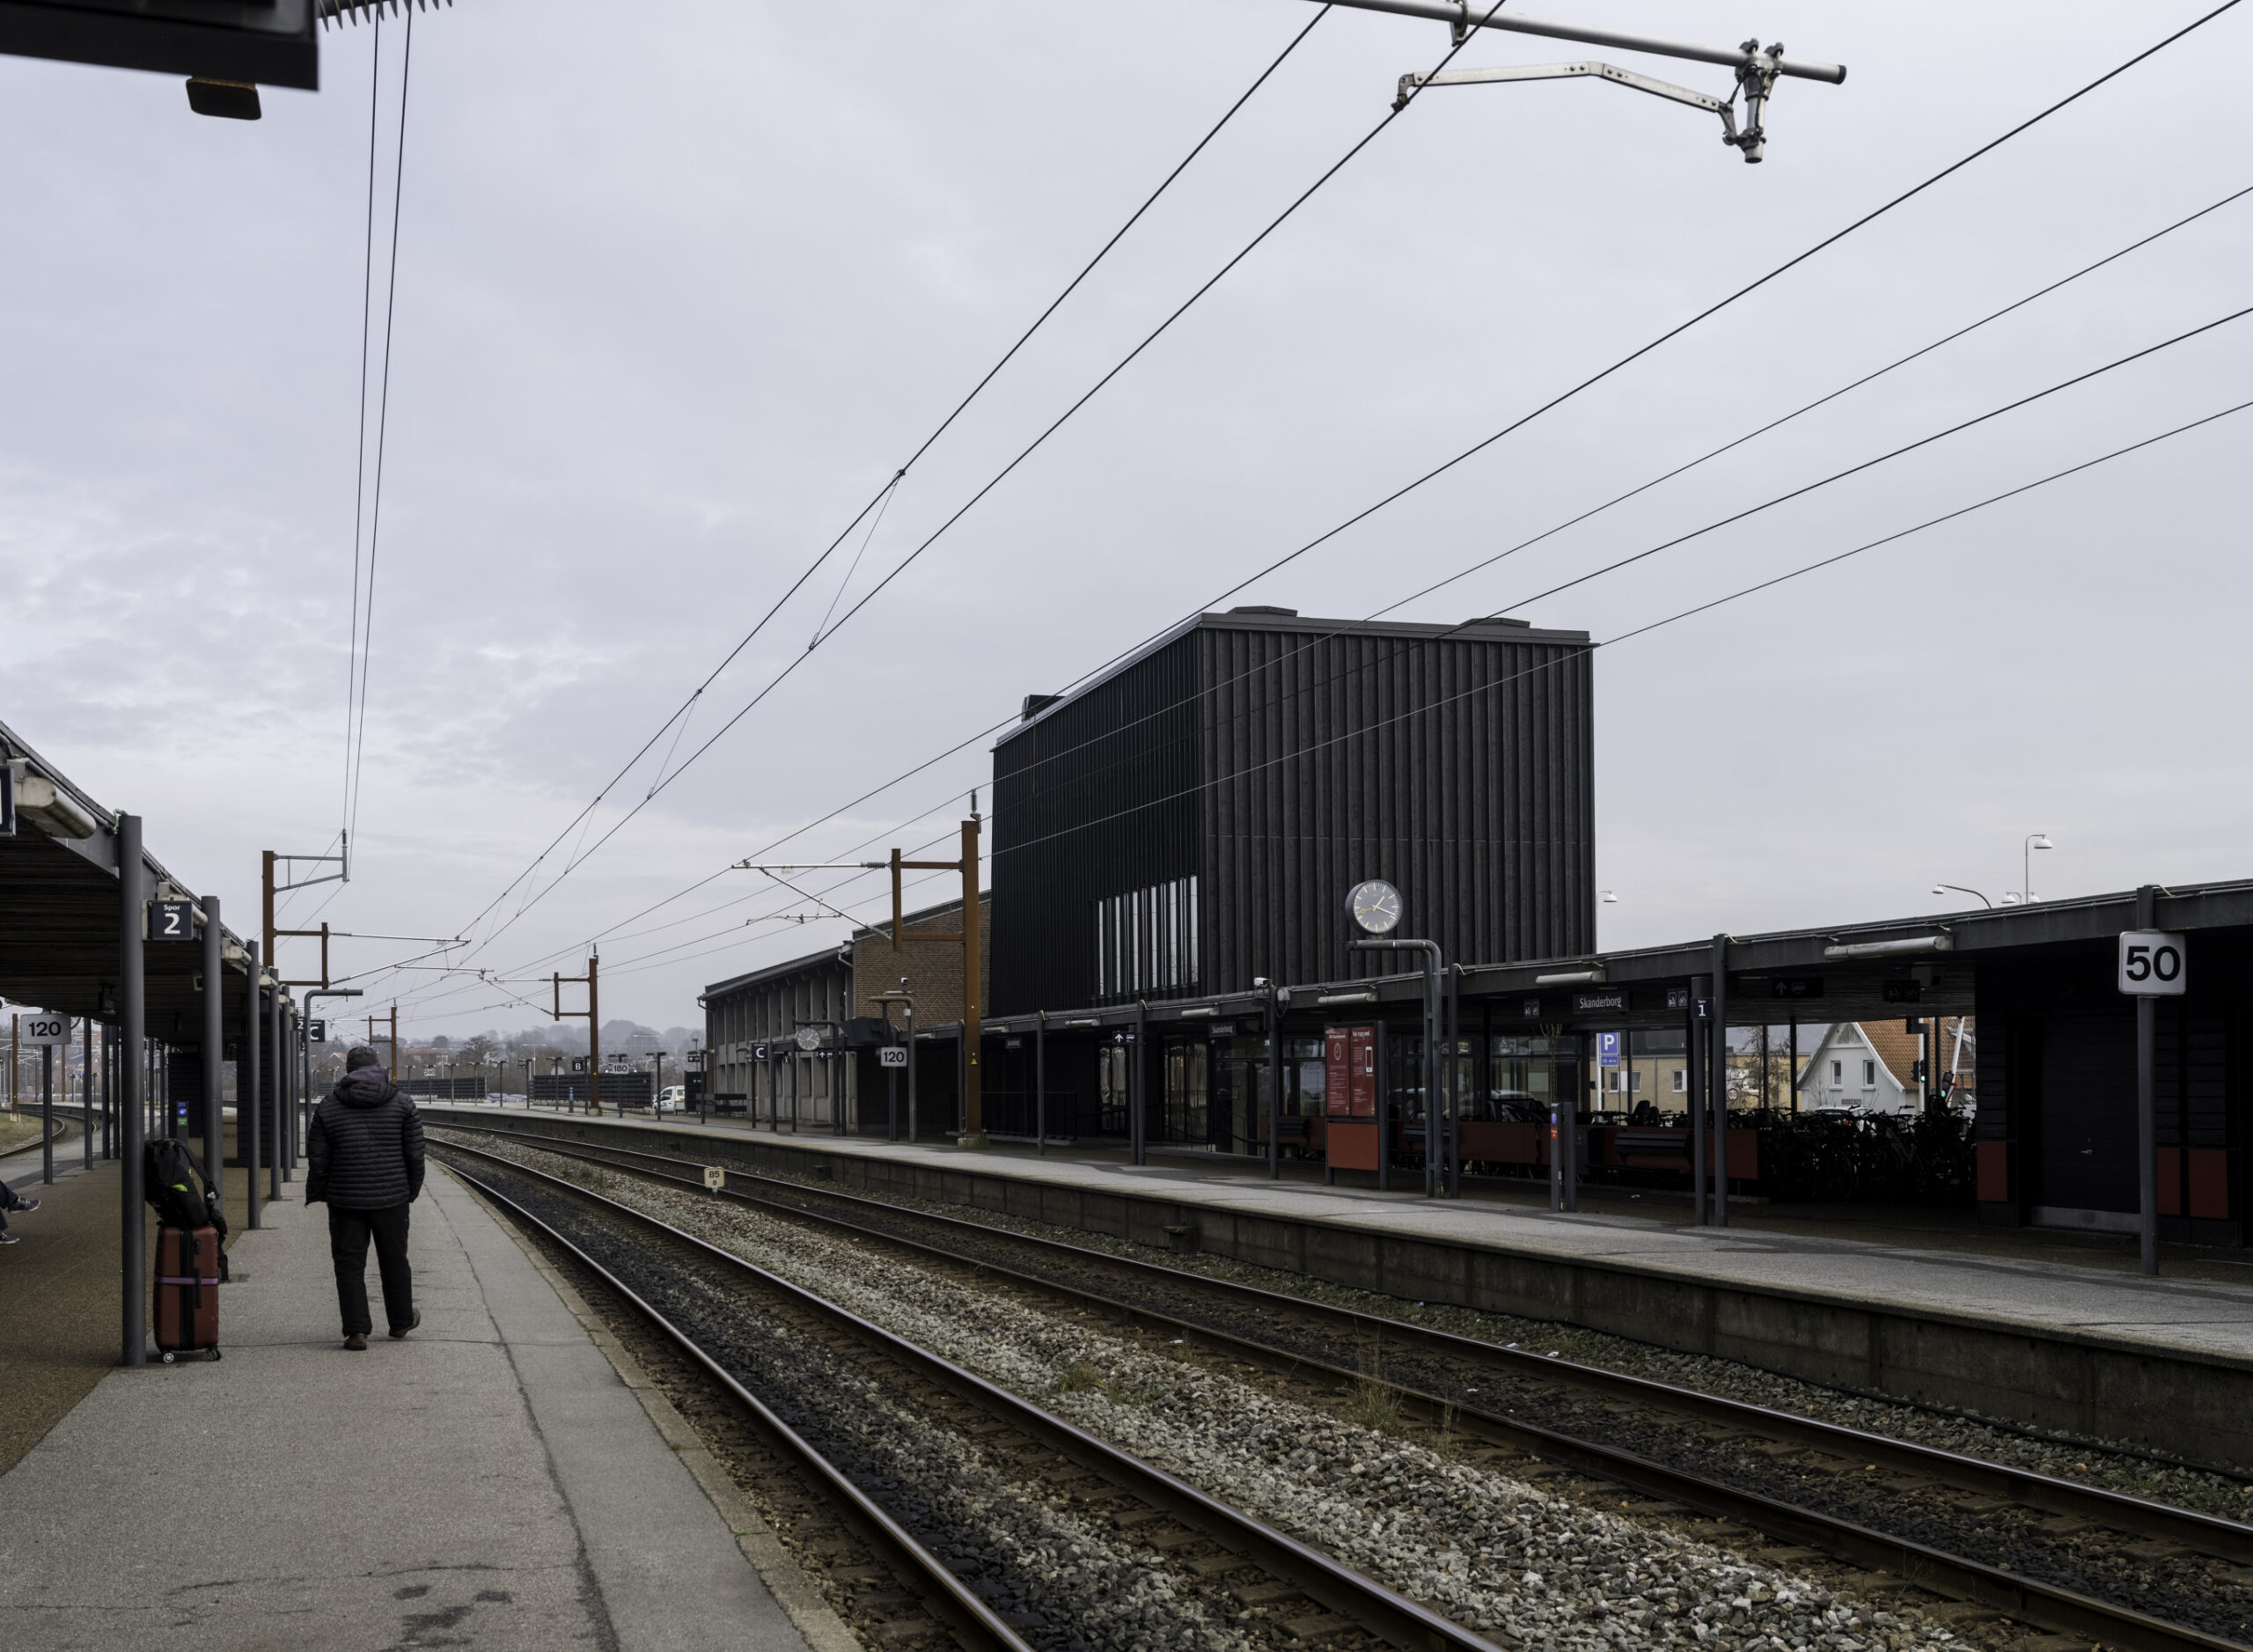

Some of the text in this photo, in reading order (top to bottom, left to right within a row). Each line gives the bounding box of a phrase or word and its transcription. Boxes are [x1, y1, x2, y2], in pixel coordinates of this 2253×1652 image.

[164, 913, 181, 935] 2
[2126, 945, 2181, 982] 50
[1579, 995, 1622, 1009] Skanderborg
[1698, 1004, 1706, 1017] 1
[28, 1021, 62, 1037] 120
[1604, 1034, 1615, 1051] P
[755, 1047, 765, 1058] C
[884, 1051, 905, 1063] 120
